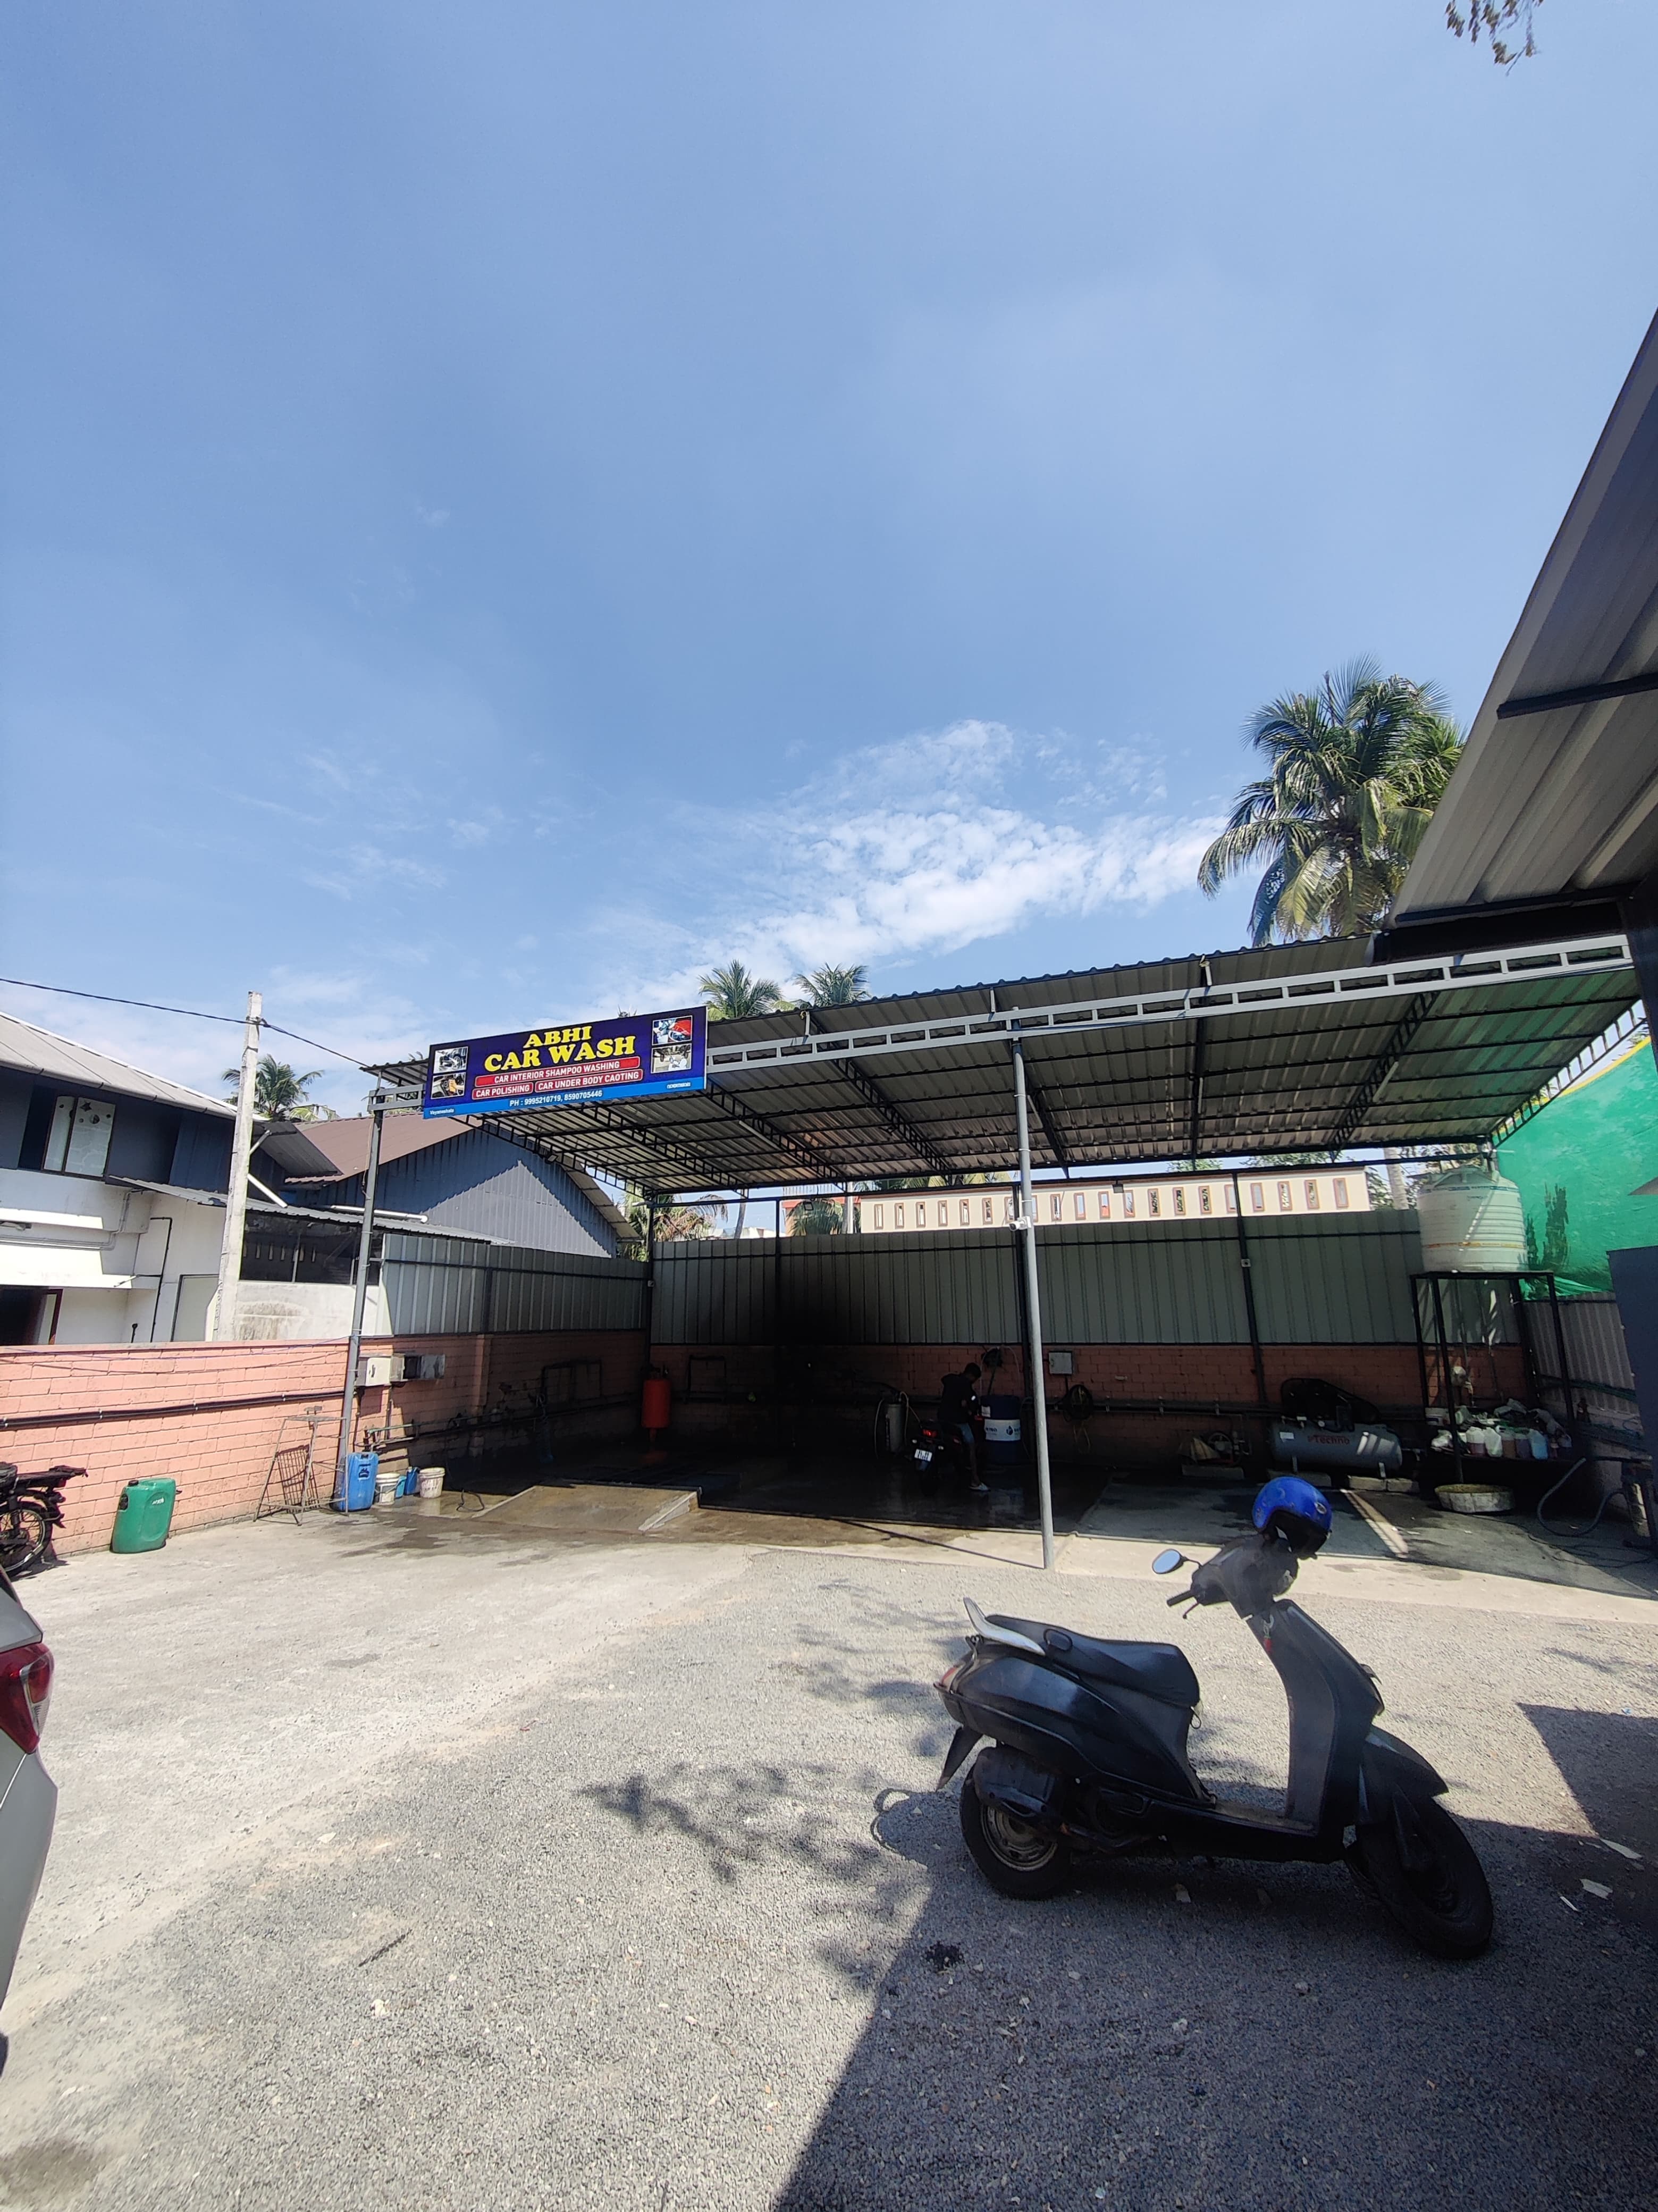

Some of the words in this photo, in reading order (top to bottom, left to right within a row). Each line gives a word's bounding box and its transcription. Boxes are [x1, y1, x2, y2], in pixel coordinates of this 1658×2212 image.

[523, 1026, 592, 1048] ABHI
[484, 1049, 541, 1072] CAR
[548, 1036, 636, 1063] WASH
[494, 1075, 509, 1084] CAR
[510, 1071, 544, 1082] INTERIOR
[545, 1066, 582, 1077] SHAMPOO
[584, 1061, 620, 1073] WASHING
[554, 1079, 580, 1088] UNDER
[583, 1076, 603, 1085] BODY
[604, 1071, 639, 1083] CAOTING
[492, 1085, 529, 1096] POLISHING
[524, 1095, 563, 1105] 9995210719,
[564, 1090, 602, 1101] 8590705446
